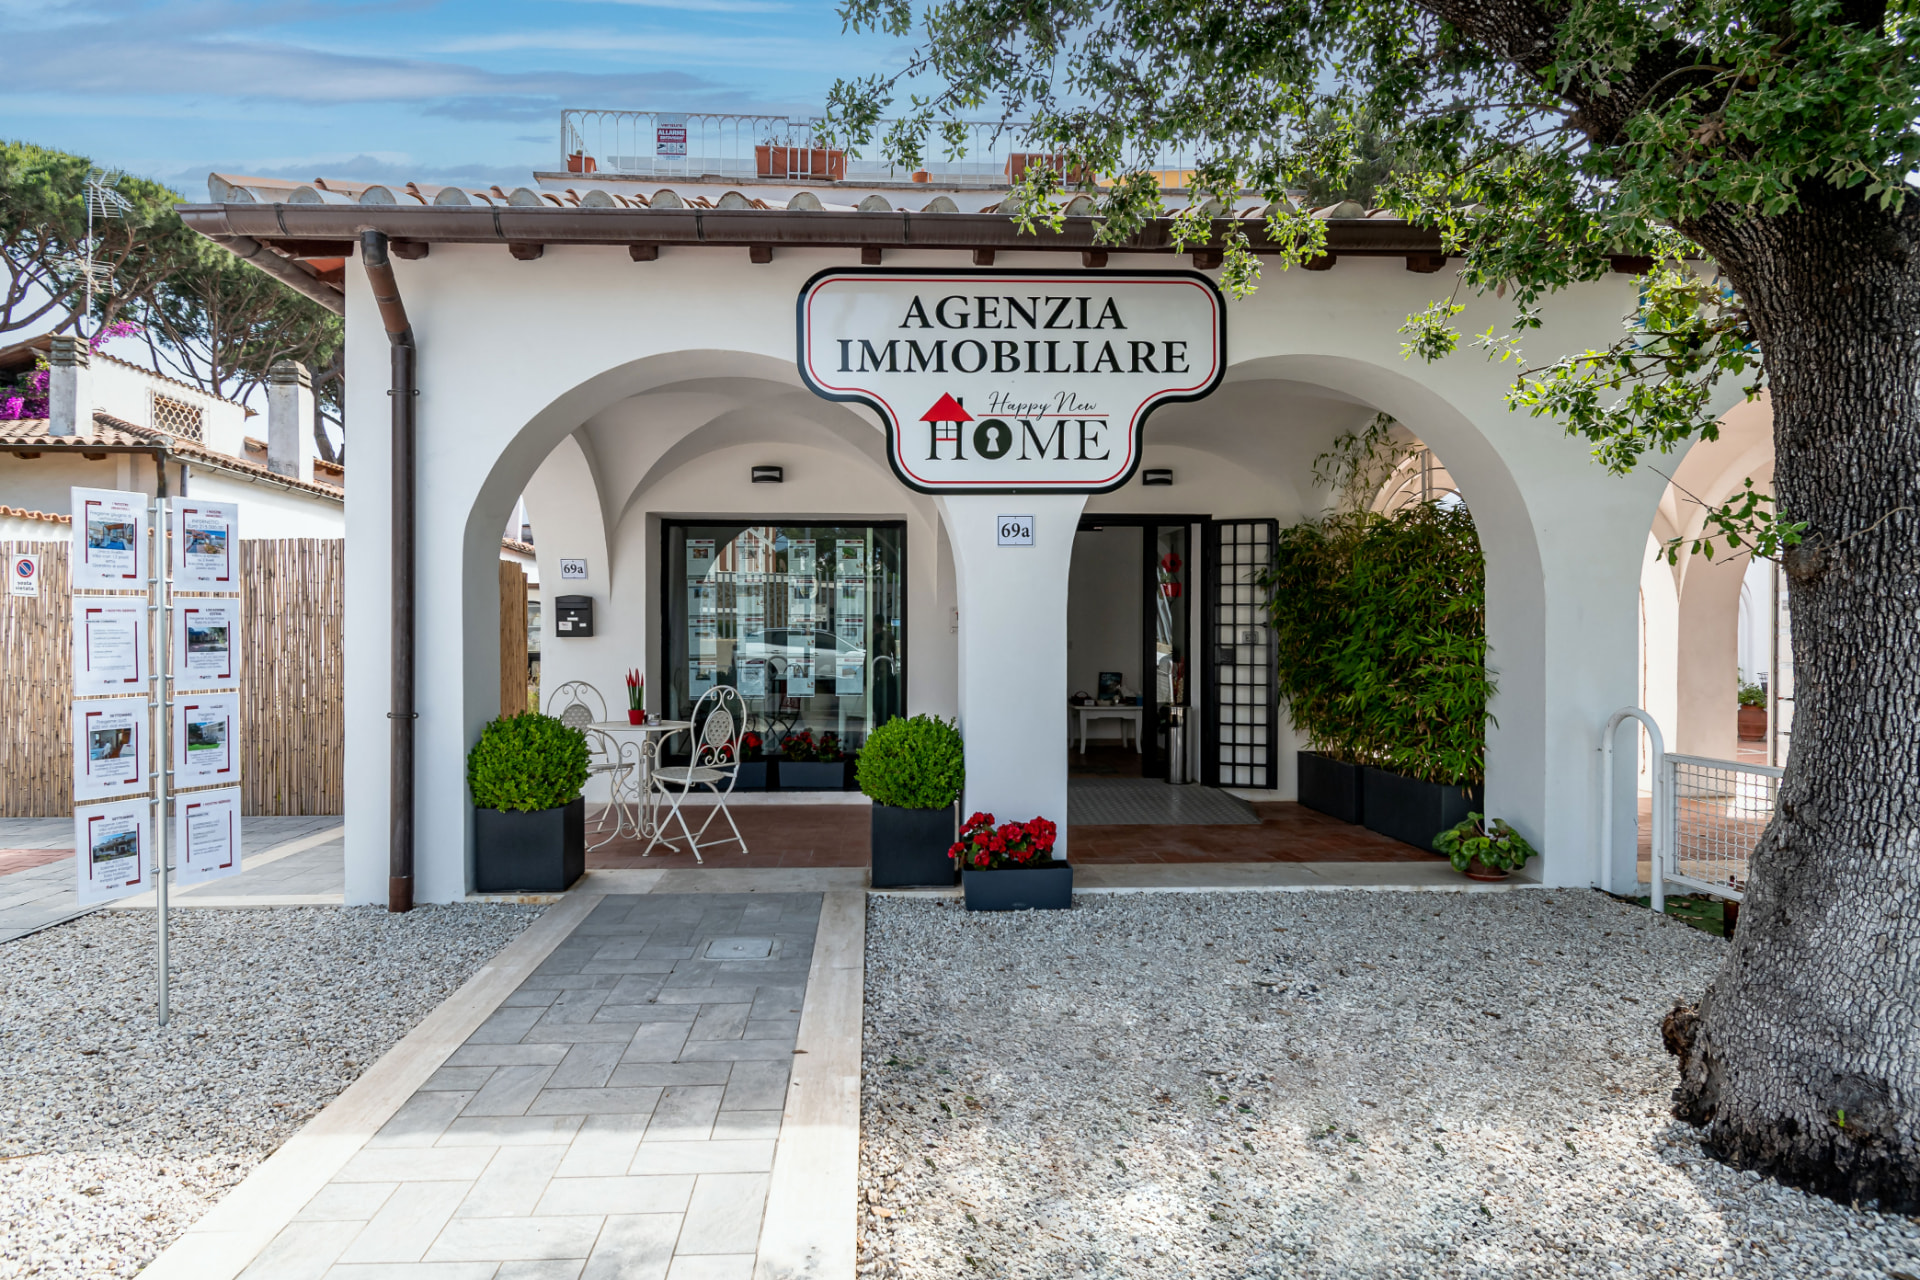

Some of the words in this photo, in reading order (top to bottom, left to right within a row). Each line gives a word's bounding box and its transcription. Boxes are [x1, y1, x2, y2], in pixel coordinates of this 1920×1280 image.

[898, 295, 1128, 330] AGENZIA
[836, 339, 1190, 374] IMMOBILIARE
[988, 391, 1050, 419] Happy
[1053, 391, 1097, 412] New
[925, 419, 1111, 461] HOME
[1000, 523, 1031, 539] 69a
[563, 564, 584, 574] 69a
